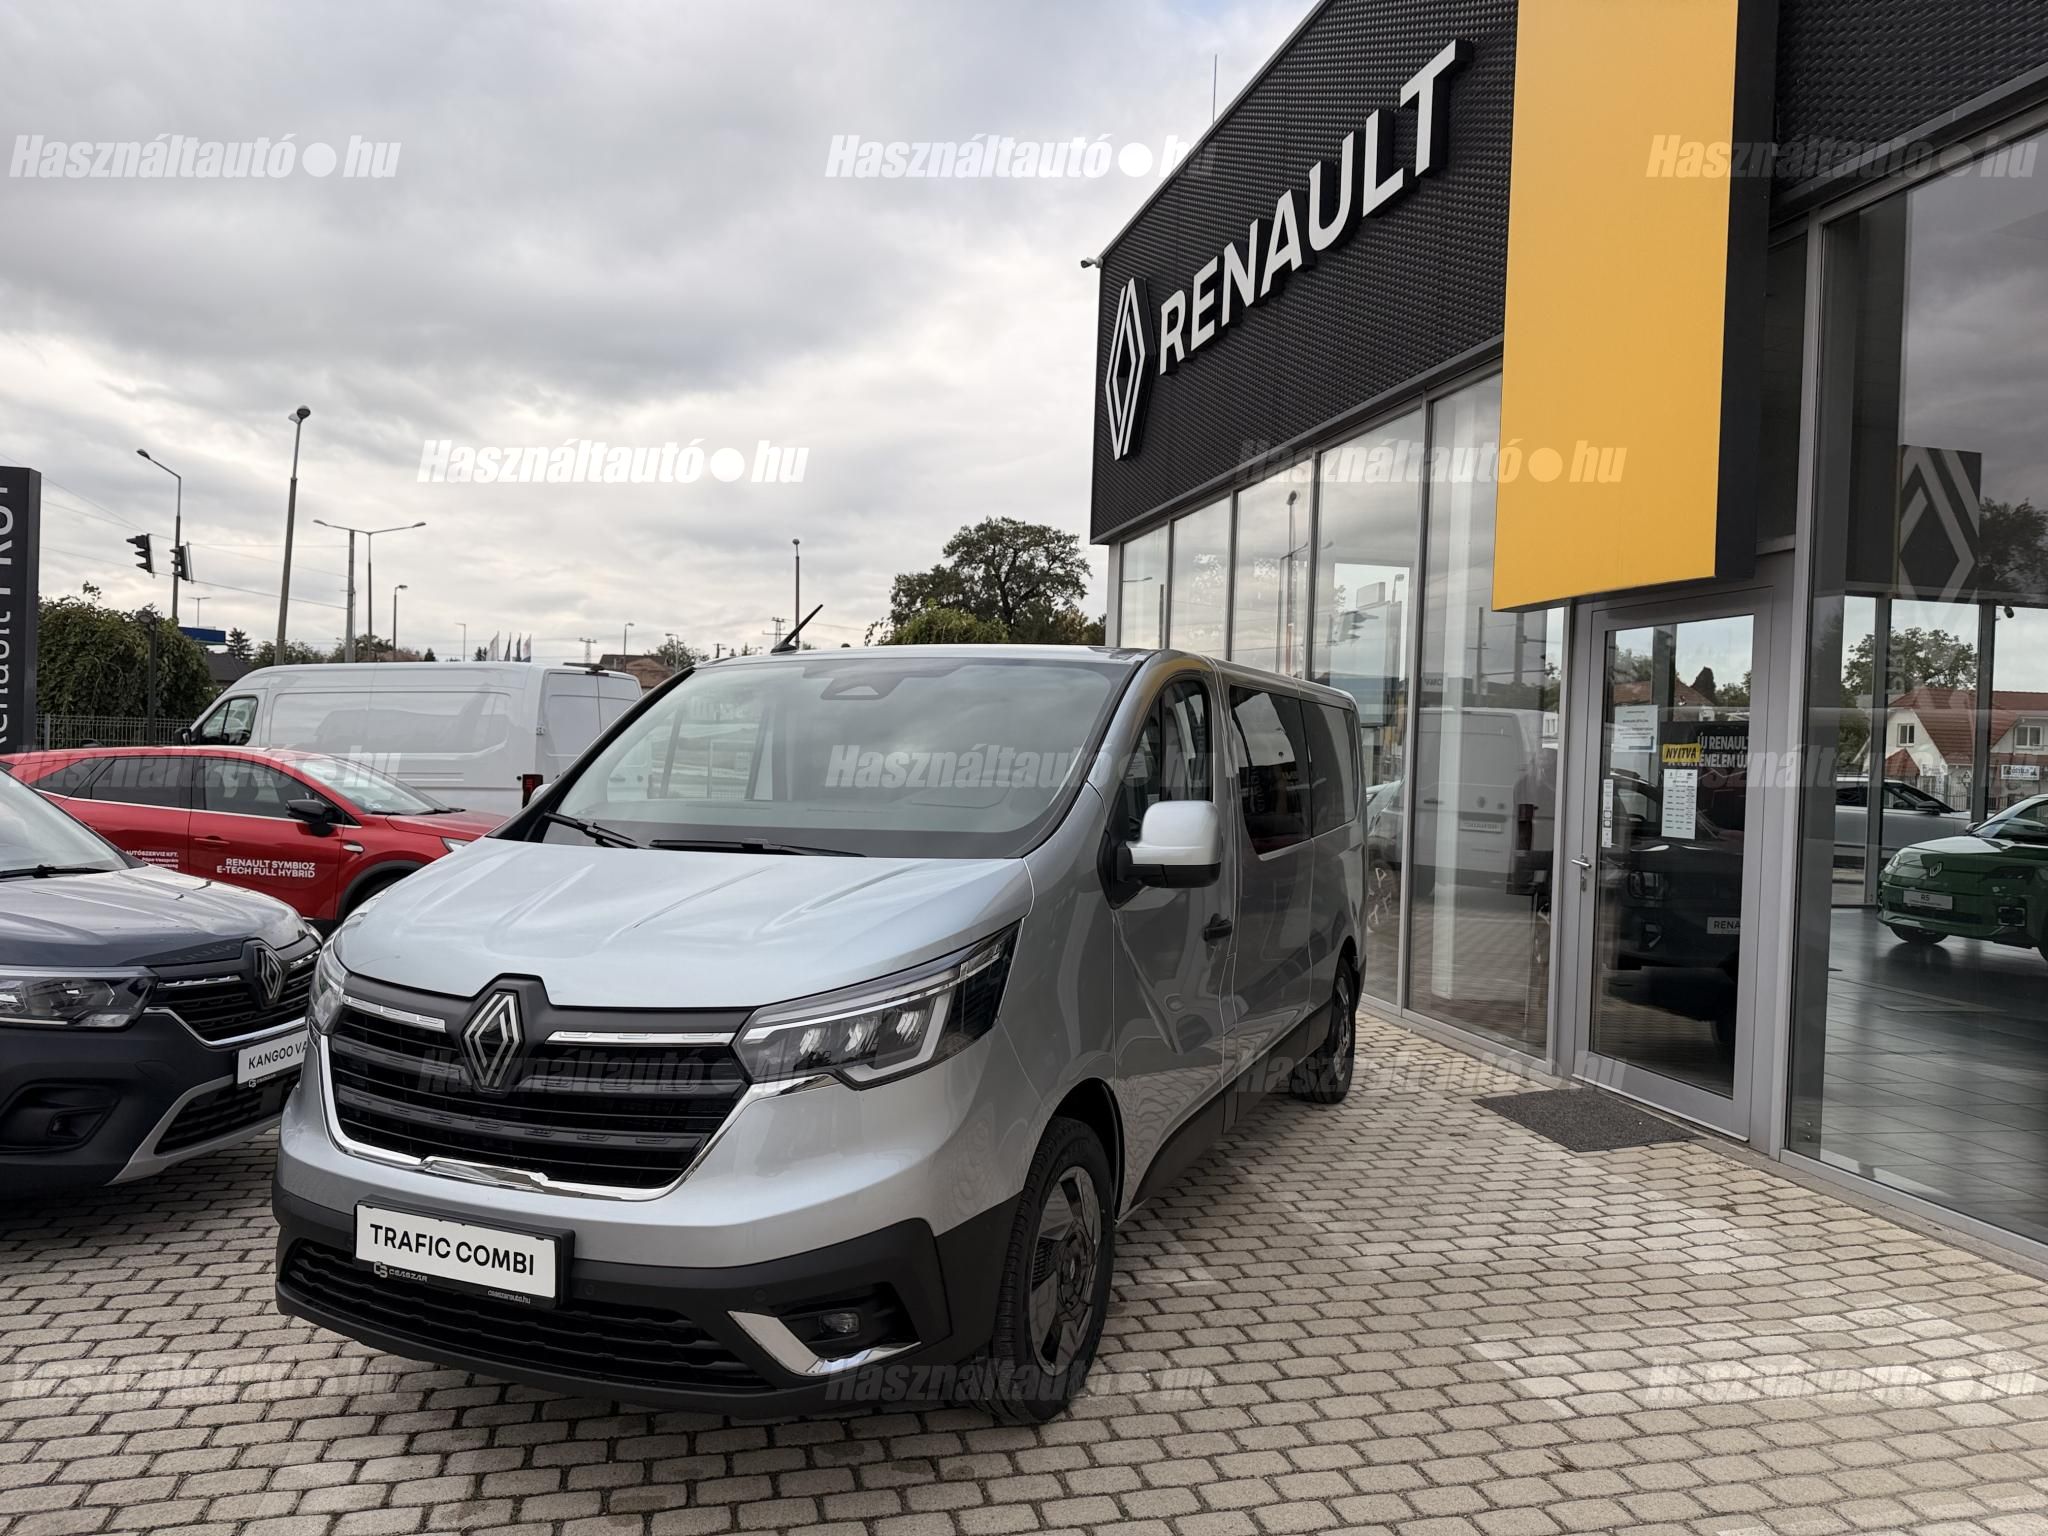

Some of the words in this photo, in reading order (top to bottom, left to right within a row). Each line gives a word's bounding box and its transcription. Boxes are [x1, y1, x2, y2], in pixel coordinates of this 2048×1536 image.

[1159, 38, 1457, 376] RENAULT
[1708, 735, 1748, 750] RENAUL
[1665, 747, 1698, 759] NYITVA
[217, 865, 251, 875] E-TECH
[253, 867, 280, 876] FULL
[280, 868, 316, 878] HYBRID
[226, 858, 269, 868] RENAULT
[272, 860, 316, 870] SYMBIOZ
[248, 1045, 294, 1070] KANGOO
[370, 1223, 451, 1259] TRAFIC
[455, 1241, 534, 1276] COMBI
